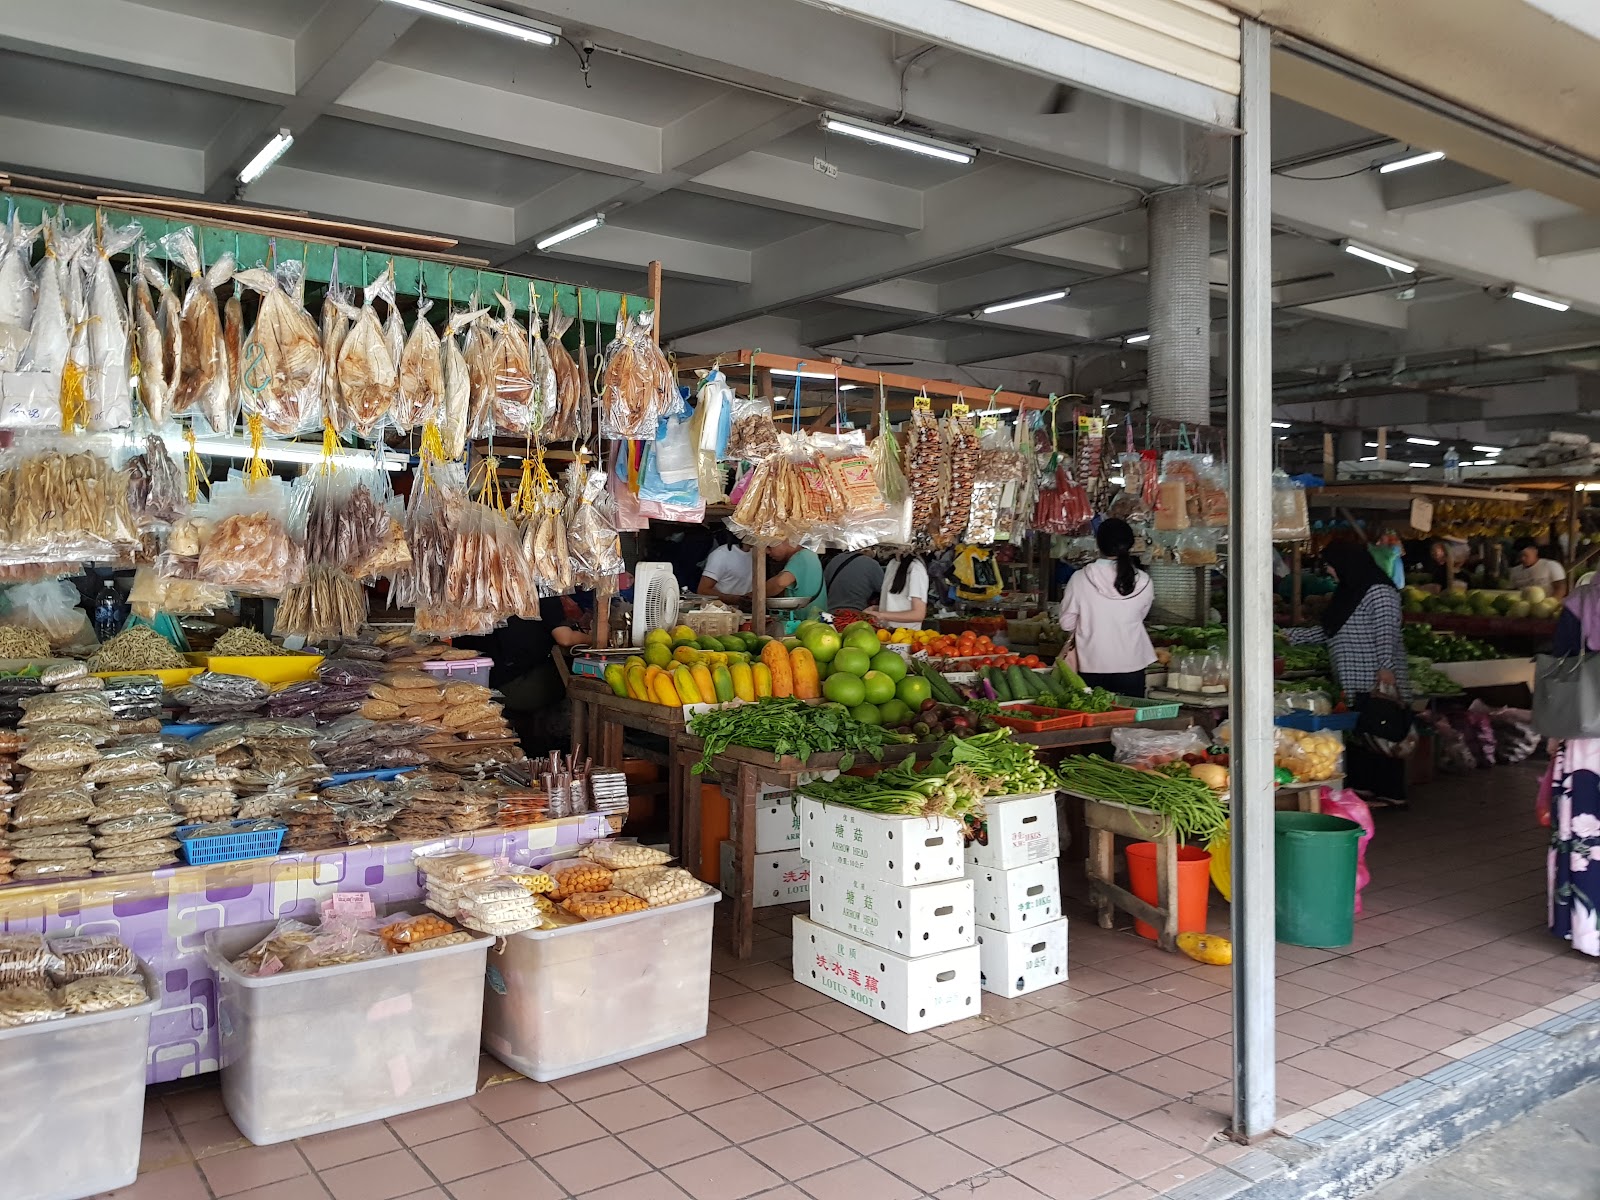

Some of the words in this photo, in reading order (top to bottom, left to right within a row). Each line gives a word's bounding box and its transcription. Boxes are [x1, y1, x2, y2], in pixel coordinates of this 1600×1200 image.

[831, 841, 850, 854] ARROW
[852, 846, 869, 859] HEAD
[842, 907, 861, 922] ARROW
[863, 913, 879, 928] HEAD
[821, 976, 848, 996] LOTUS
[850, 987, 874, 1008] ROOT
